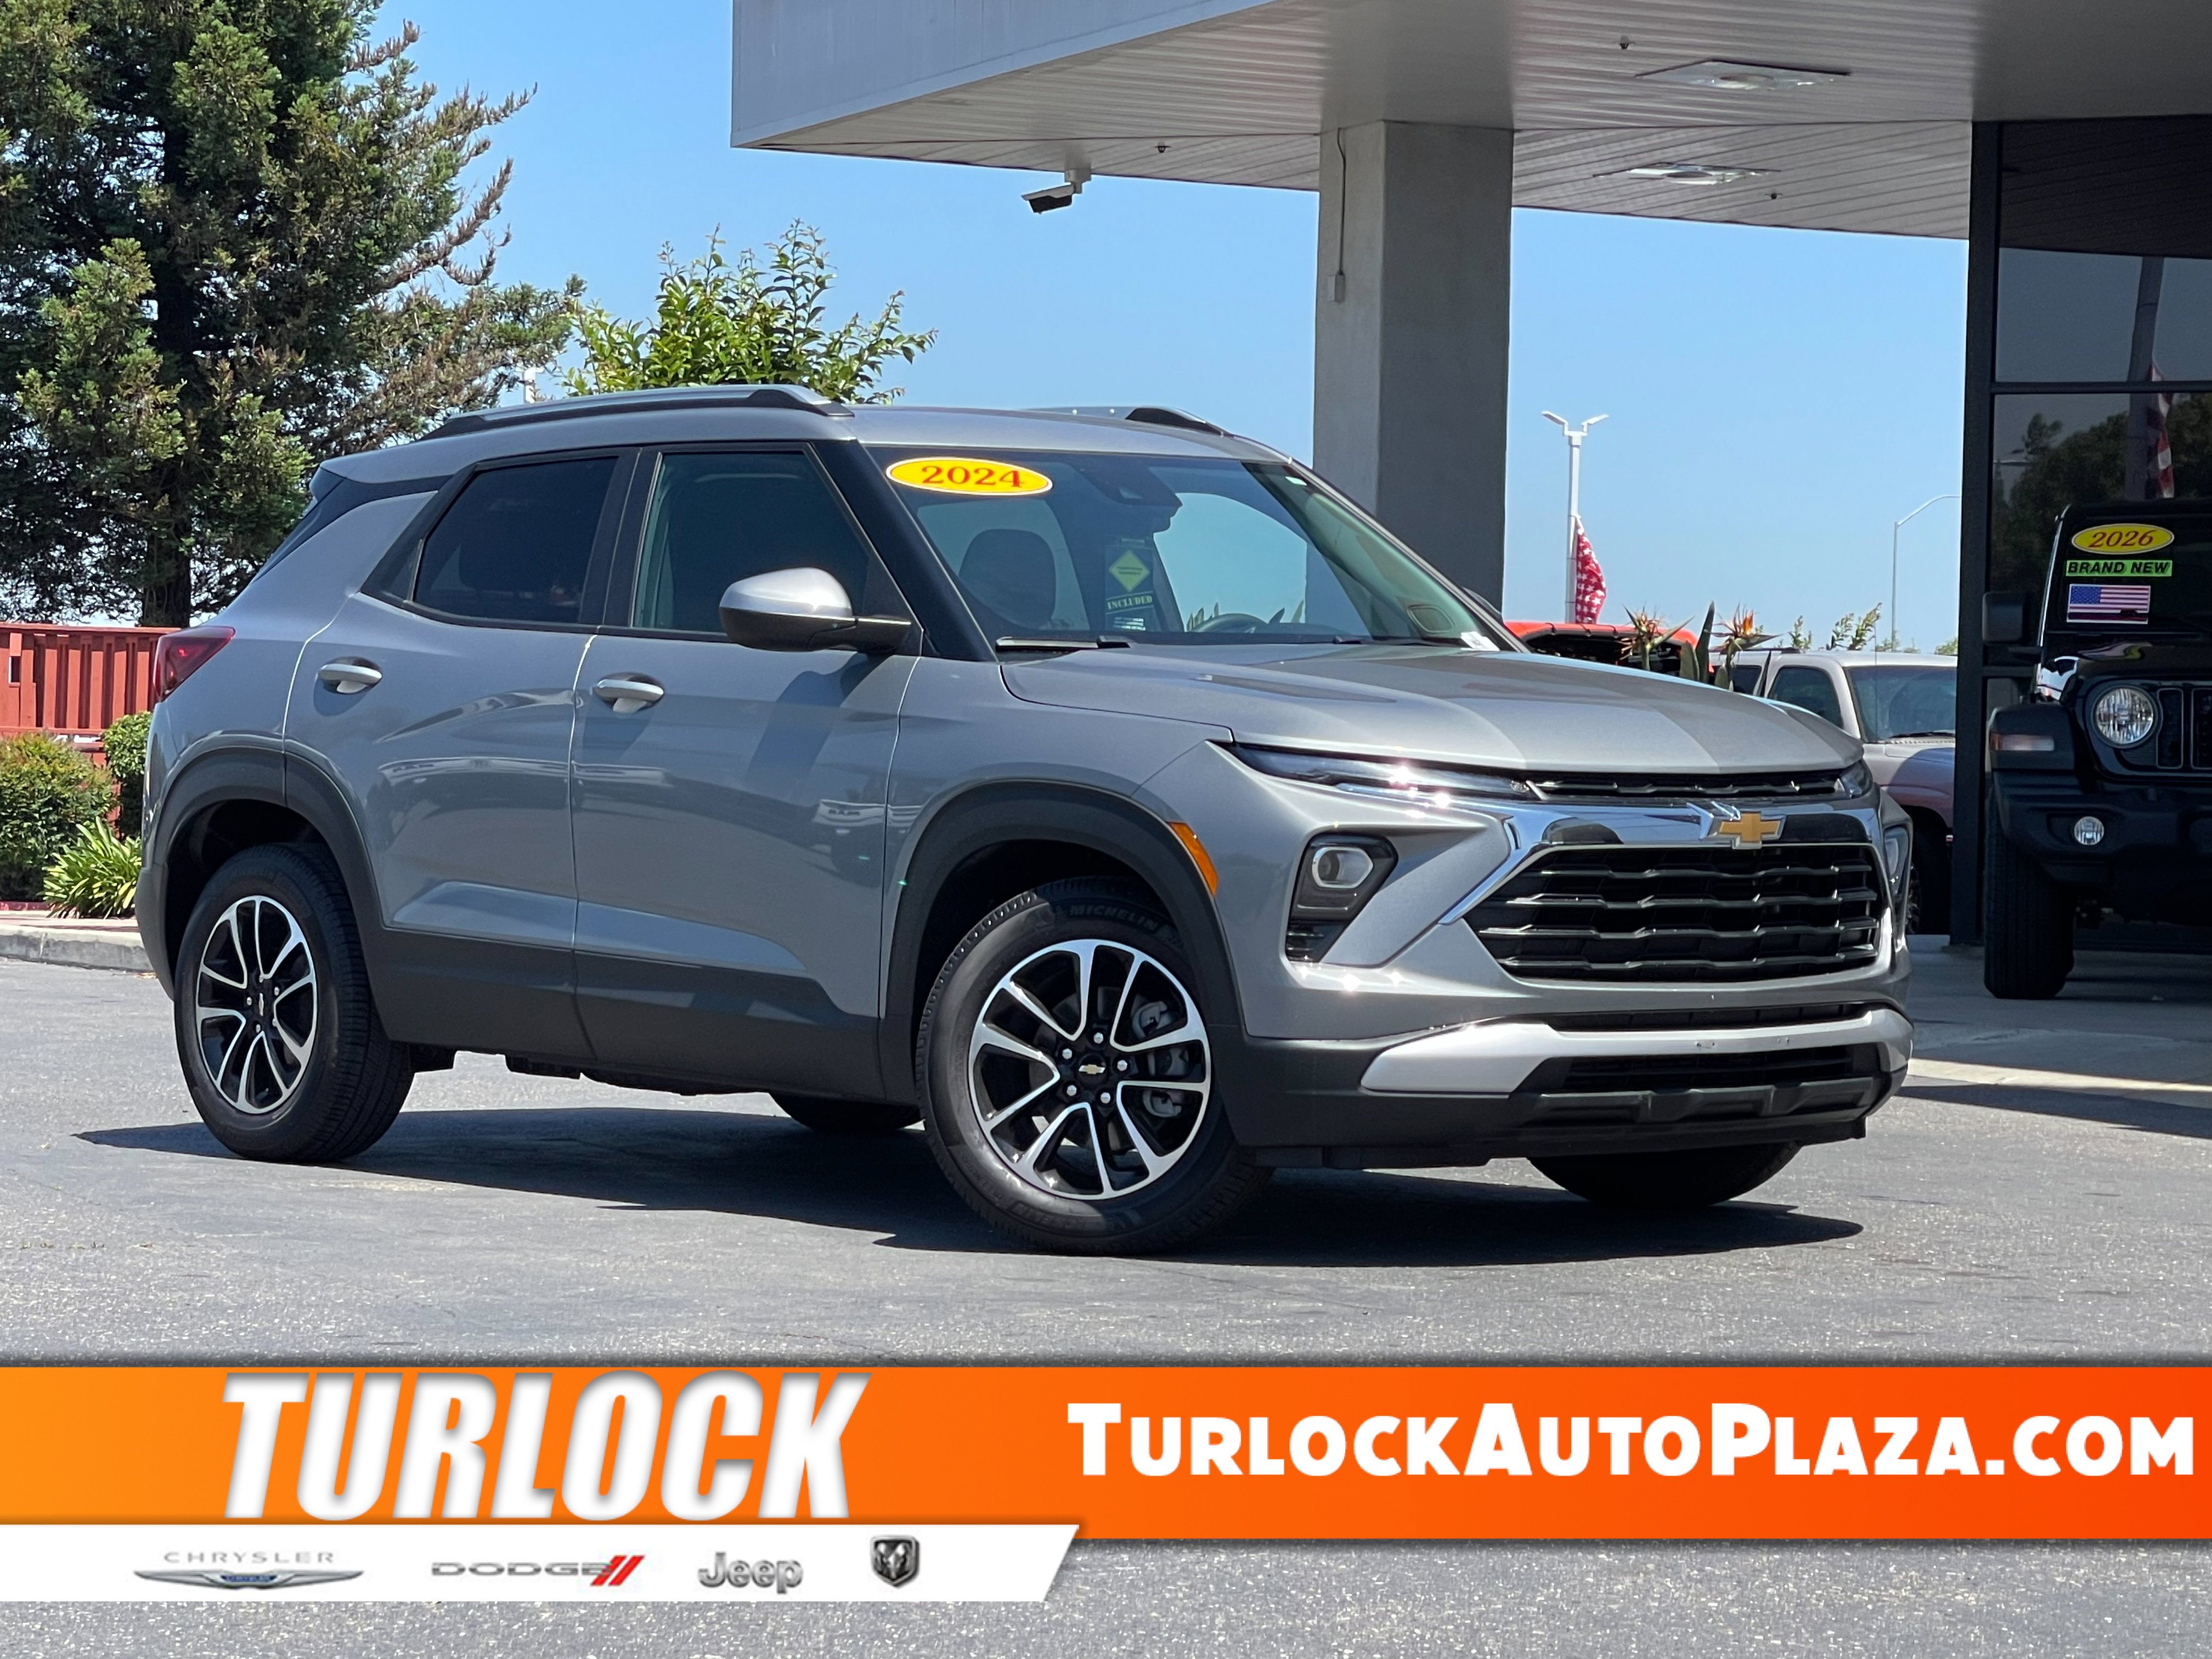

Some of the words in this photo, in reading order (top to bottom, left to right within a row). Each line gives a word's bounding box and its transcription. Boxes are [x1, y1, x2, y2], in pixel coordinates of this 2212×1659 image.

[921, 465, 1025, 488] 2024
[2089, 529, 2157, 548] 2026
[2067, 561, 2125, 573] BRAND
[2130, 562, 2170, 574] NEW
[1107, 595, 1153, 610] INCLUDED
[1070, 905, 1158, 930] MICHELIN
